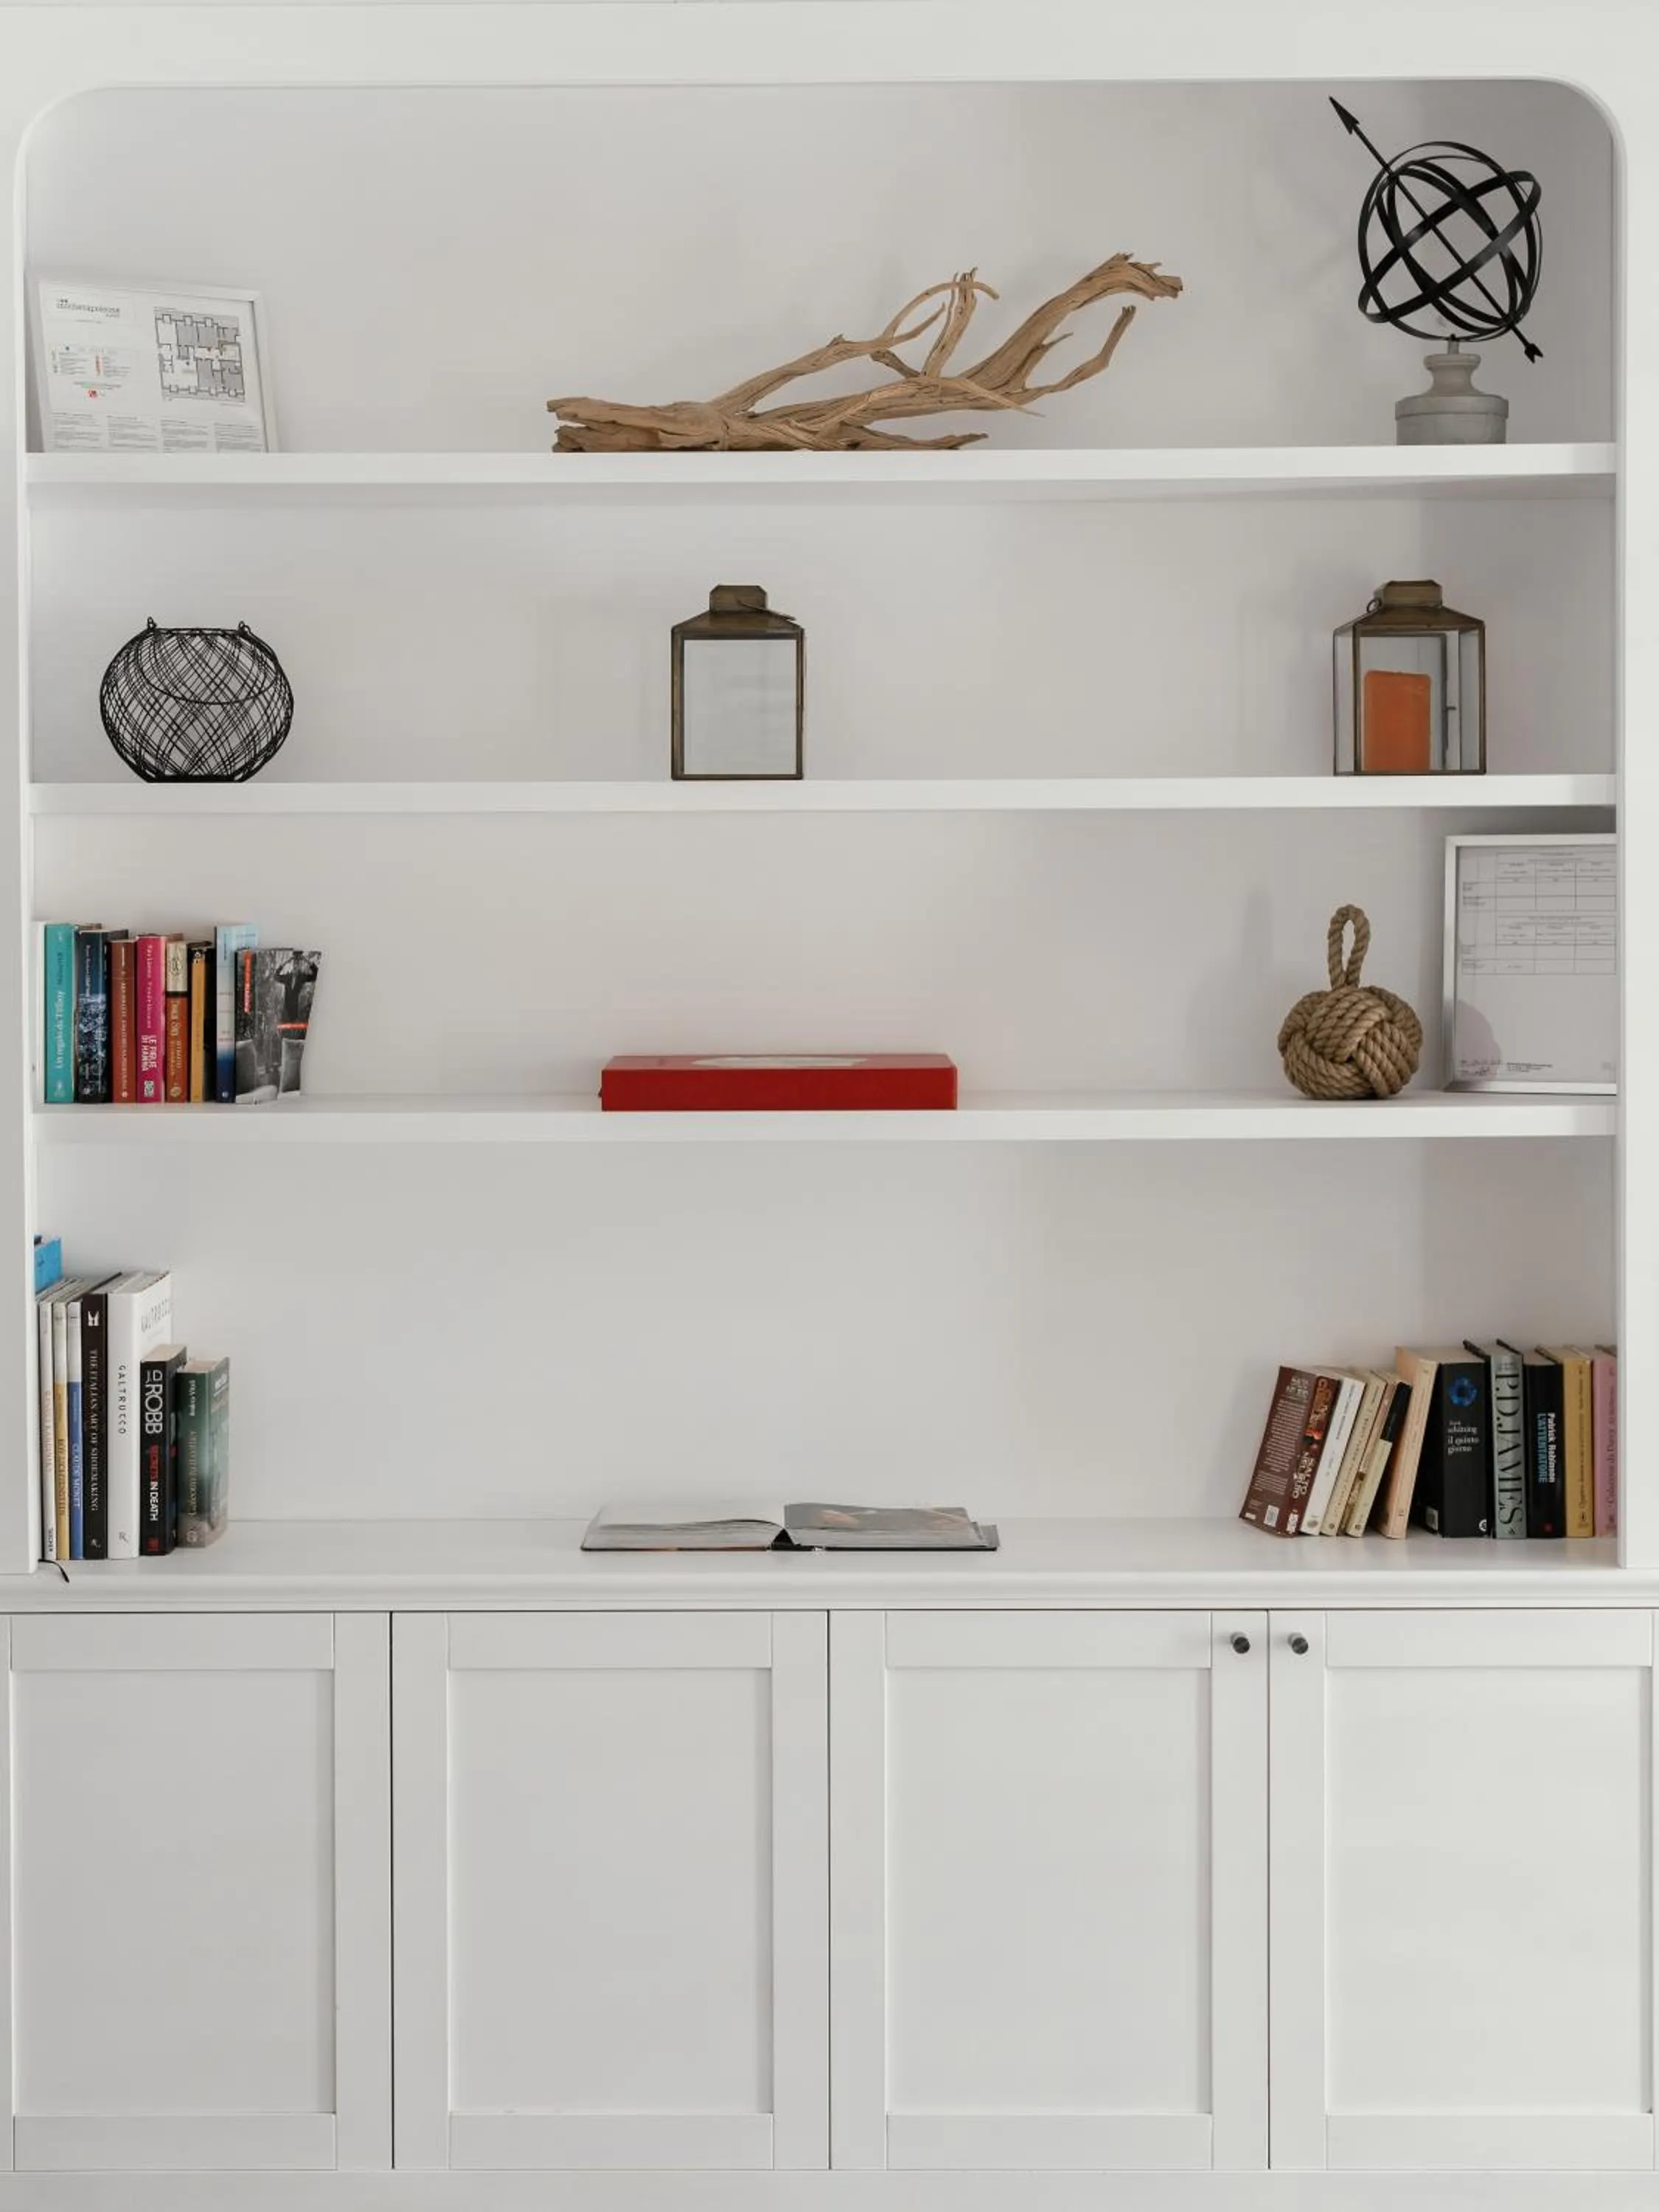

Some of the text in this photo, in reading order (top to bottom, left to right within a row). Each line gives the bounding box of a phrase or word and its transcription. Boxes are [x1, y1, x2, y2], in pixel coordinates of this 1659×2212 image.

[142, 1034, 149, 1043] DI
[142, 1044, 150, 1071] HANNA
[149, 1034, 157, 1068] LE FIGLIE
[117, 1365, 127, 1435] GALTRUCCO
[145, 1384, 163, 1435] ROBB
[89, 1349, 99, 1512] THE ITALIAN ART OF SHOEMAKING
[1537, 1413, 1547, 1484] L'ATTENTATORE
[1548, 1412, 1556, 1484] Patrick Robinson
[149, 1445, 159, 1521] SECRETS IN DEATH
[1300, 1458, 1315, 1495] SALTO
